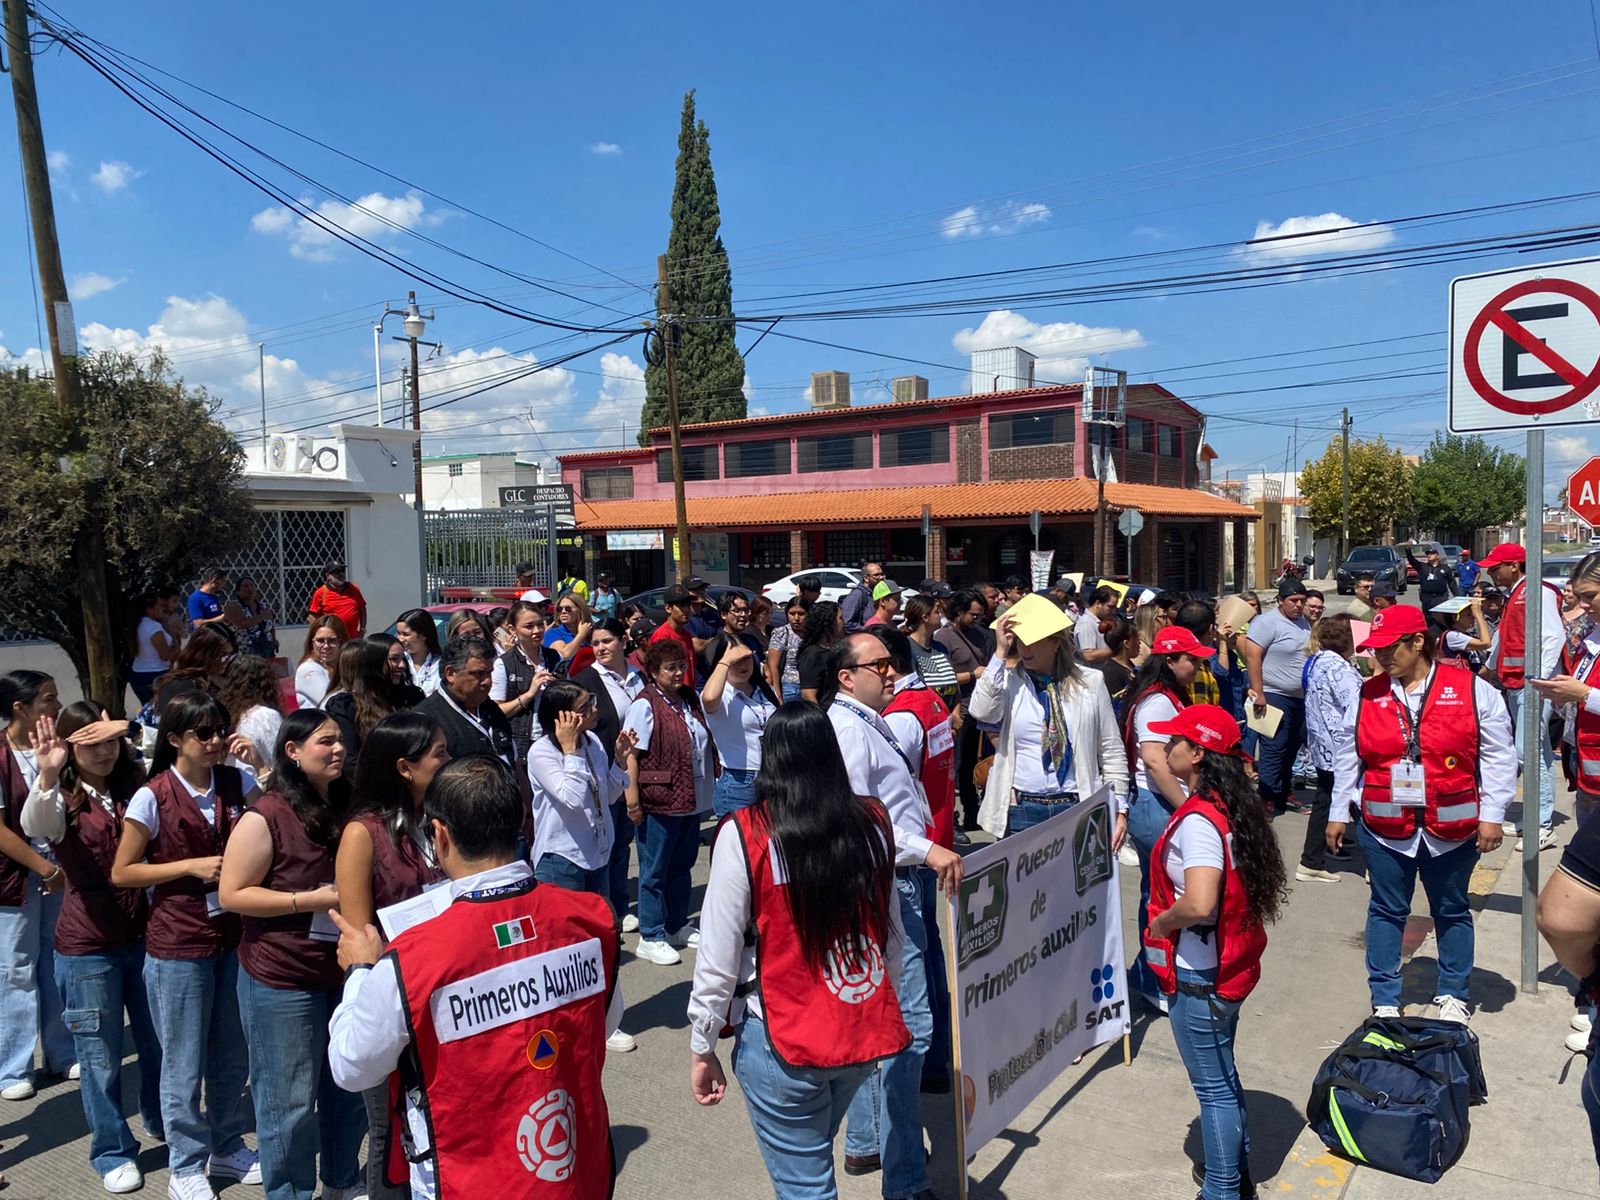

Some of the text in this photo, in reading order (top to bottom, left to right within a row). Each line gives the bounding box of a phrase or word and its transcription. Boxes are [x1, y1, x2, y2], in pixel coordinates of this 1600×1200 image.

[1503, 303, 1568, 391] E
[504, 489, 526, 502] GLC
[1579, 481, 1600, 505] A
[1016, 836, 1065, 882] Puesto
[1030, 889, 1046, 922] de
[965, 905, 1097, 1018] Primeros auxilios
[449, 952, 599, 1030] Primeros Auxilios
[1085, 1000, 1125, 1030] SAT
